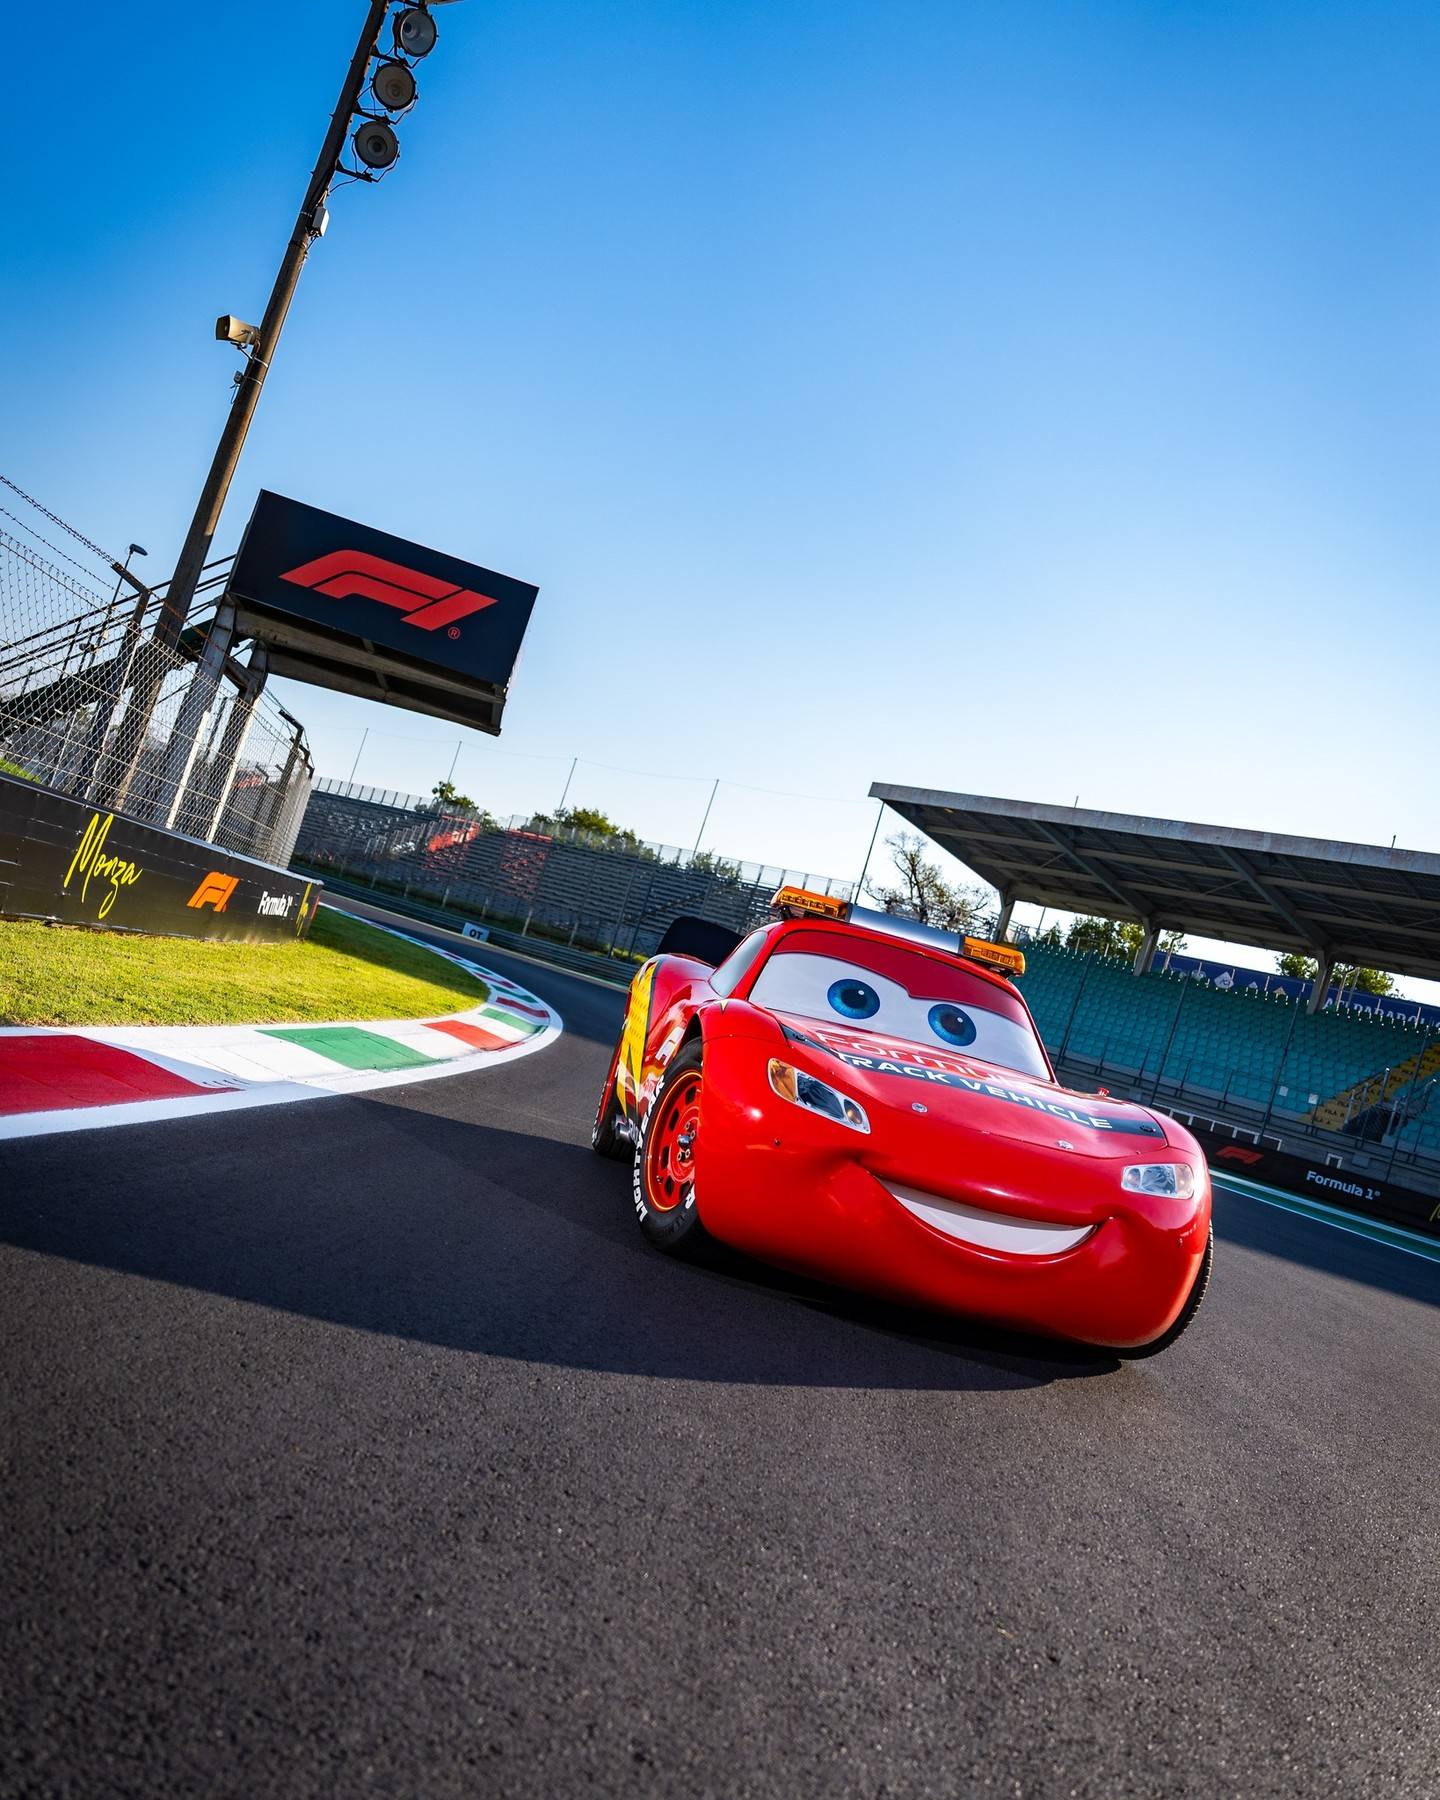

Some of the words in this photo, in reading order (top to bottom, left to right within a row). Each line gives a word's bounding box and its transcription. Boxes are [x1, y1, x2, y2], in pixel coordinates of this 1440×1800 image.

[278, 549, 498, 632] F1
[63, 812, 143, 919] Monza
[257, 890, 287, 916] Formula
[831, 1049, 952, 1084] TRACK
[959, 1078, 1113, 1129] VEHICLE
[633, 1074, 665, 1223] LIGHTYEAR
[1216, 1146, 1265, 1165] F1
[1306, 1170, 1363, 1198] Formula
